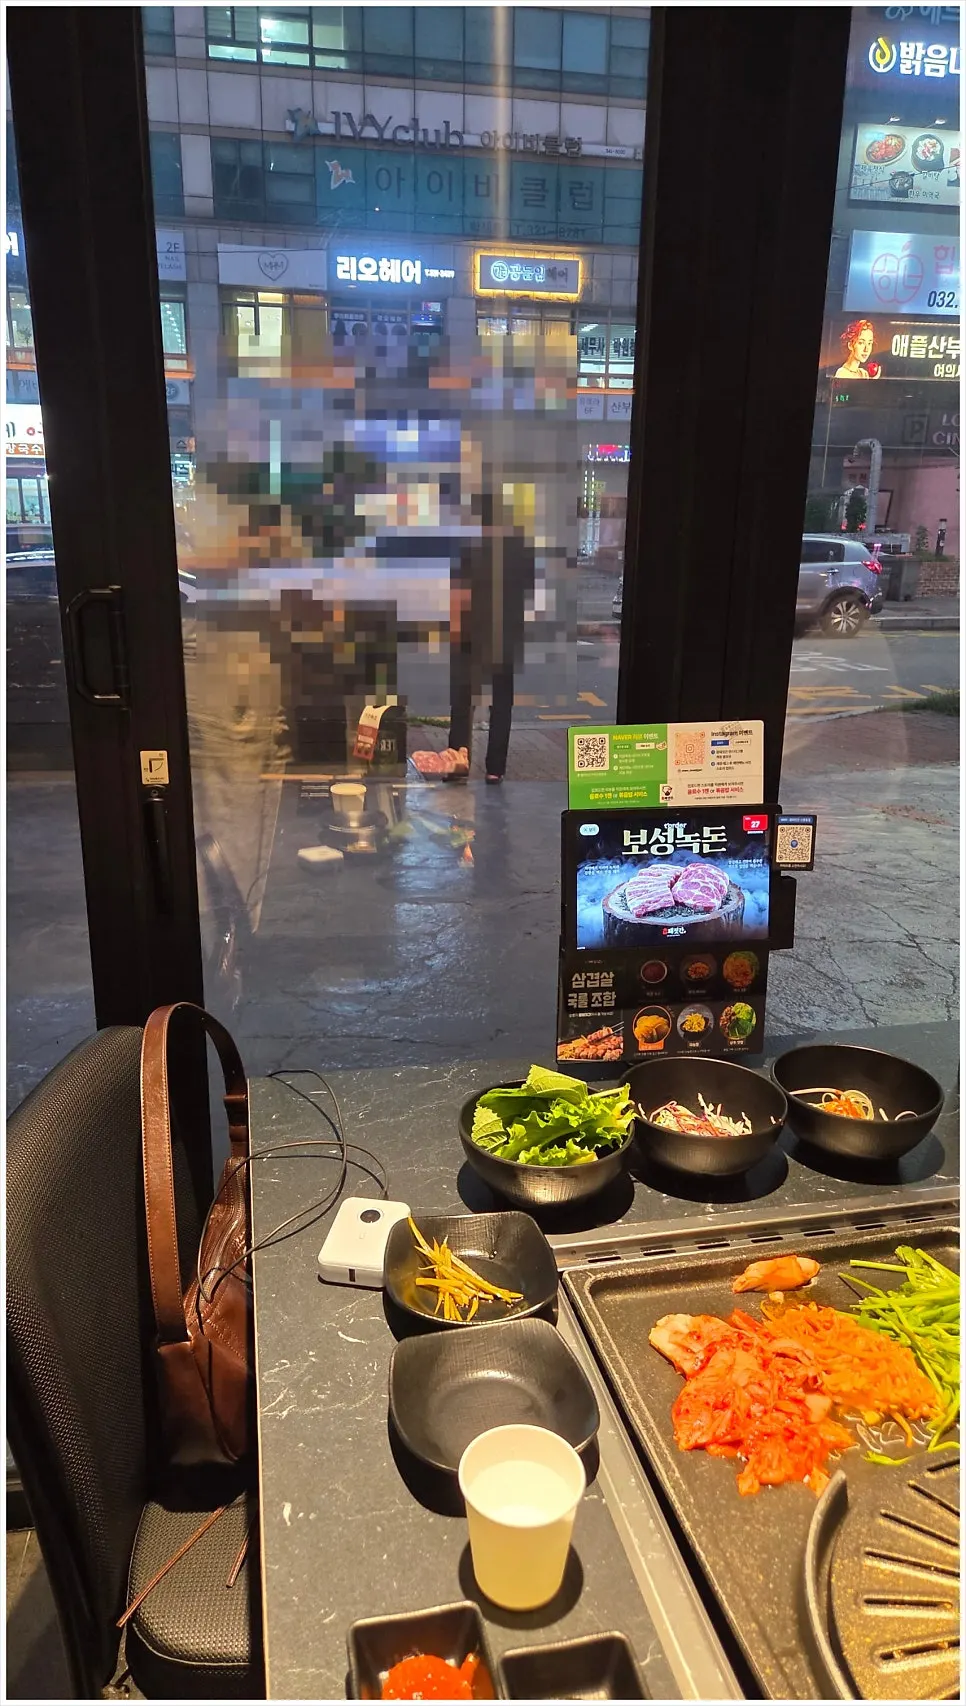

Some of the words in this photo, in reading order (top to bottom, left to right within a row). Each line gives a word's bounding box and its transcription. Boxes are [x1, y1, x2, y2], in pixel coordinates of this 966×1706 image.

[331, 111, 463, 149] IVYclub
[375, 166, 595, 211] 아이비클럽
[166, 241, 180, 253] 2F
[336, 256, 421, 285] 리오헤어
[750, 820, 761, 829] 27
[622, 825, 728, 856] 보성녹돈
[571, 971, 615, 989] 삼겹살
[567, 992, 588, 1009] 국룰
[590, 991, 617, 1008] 조합
